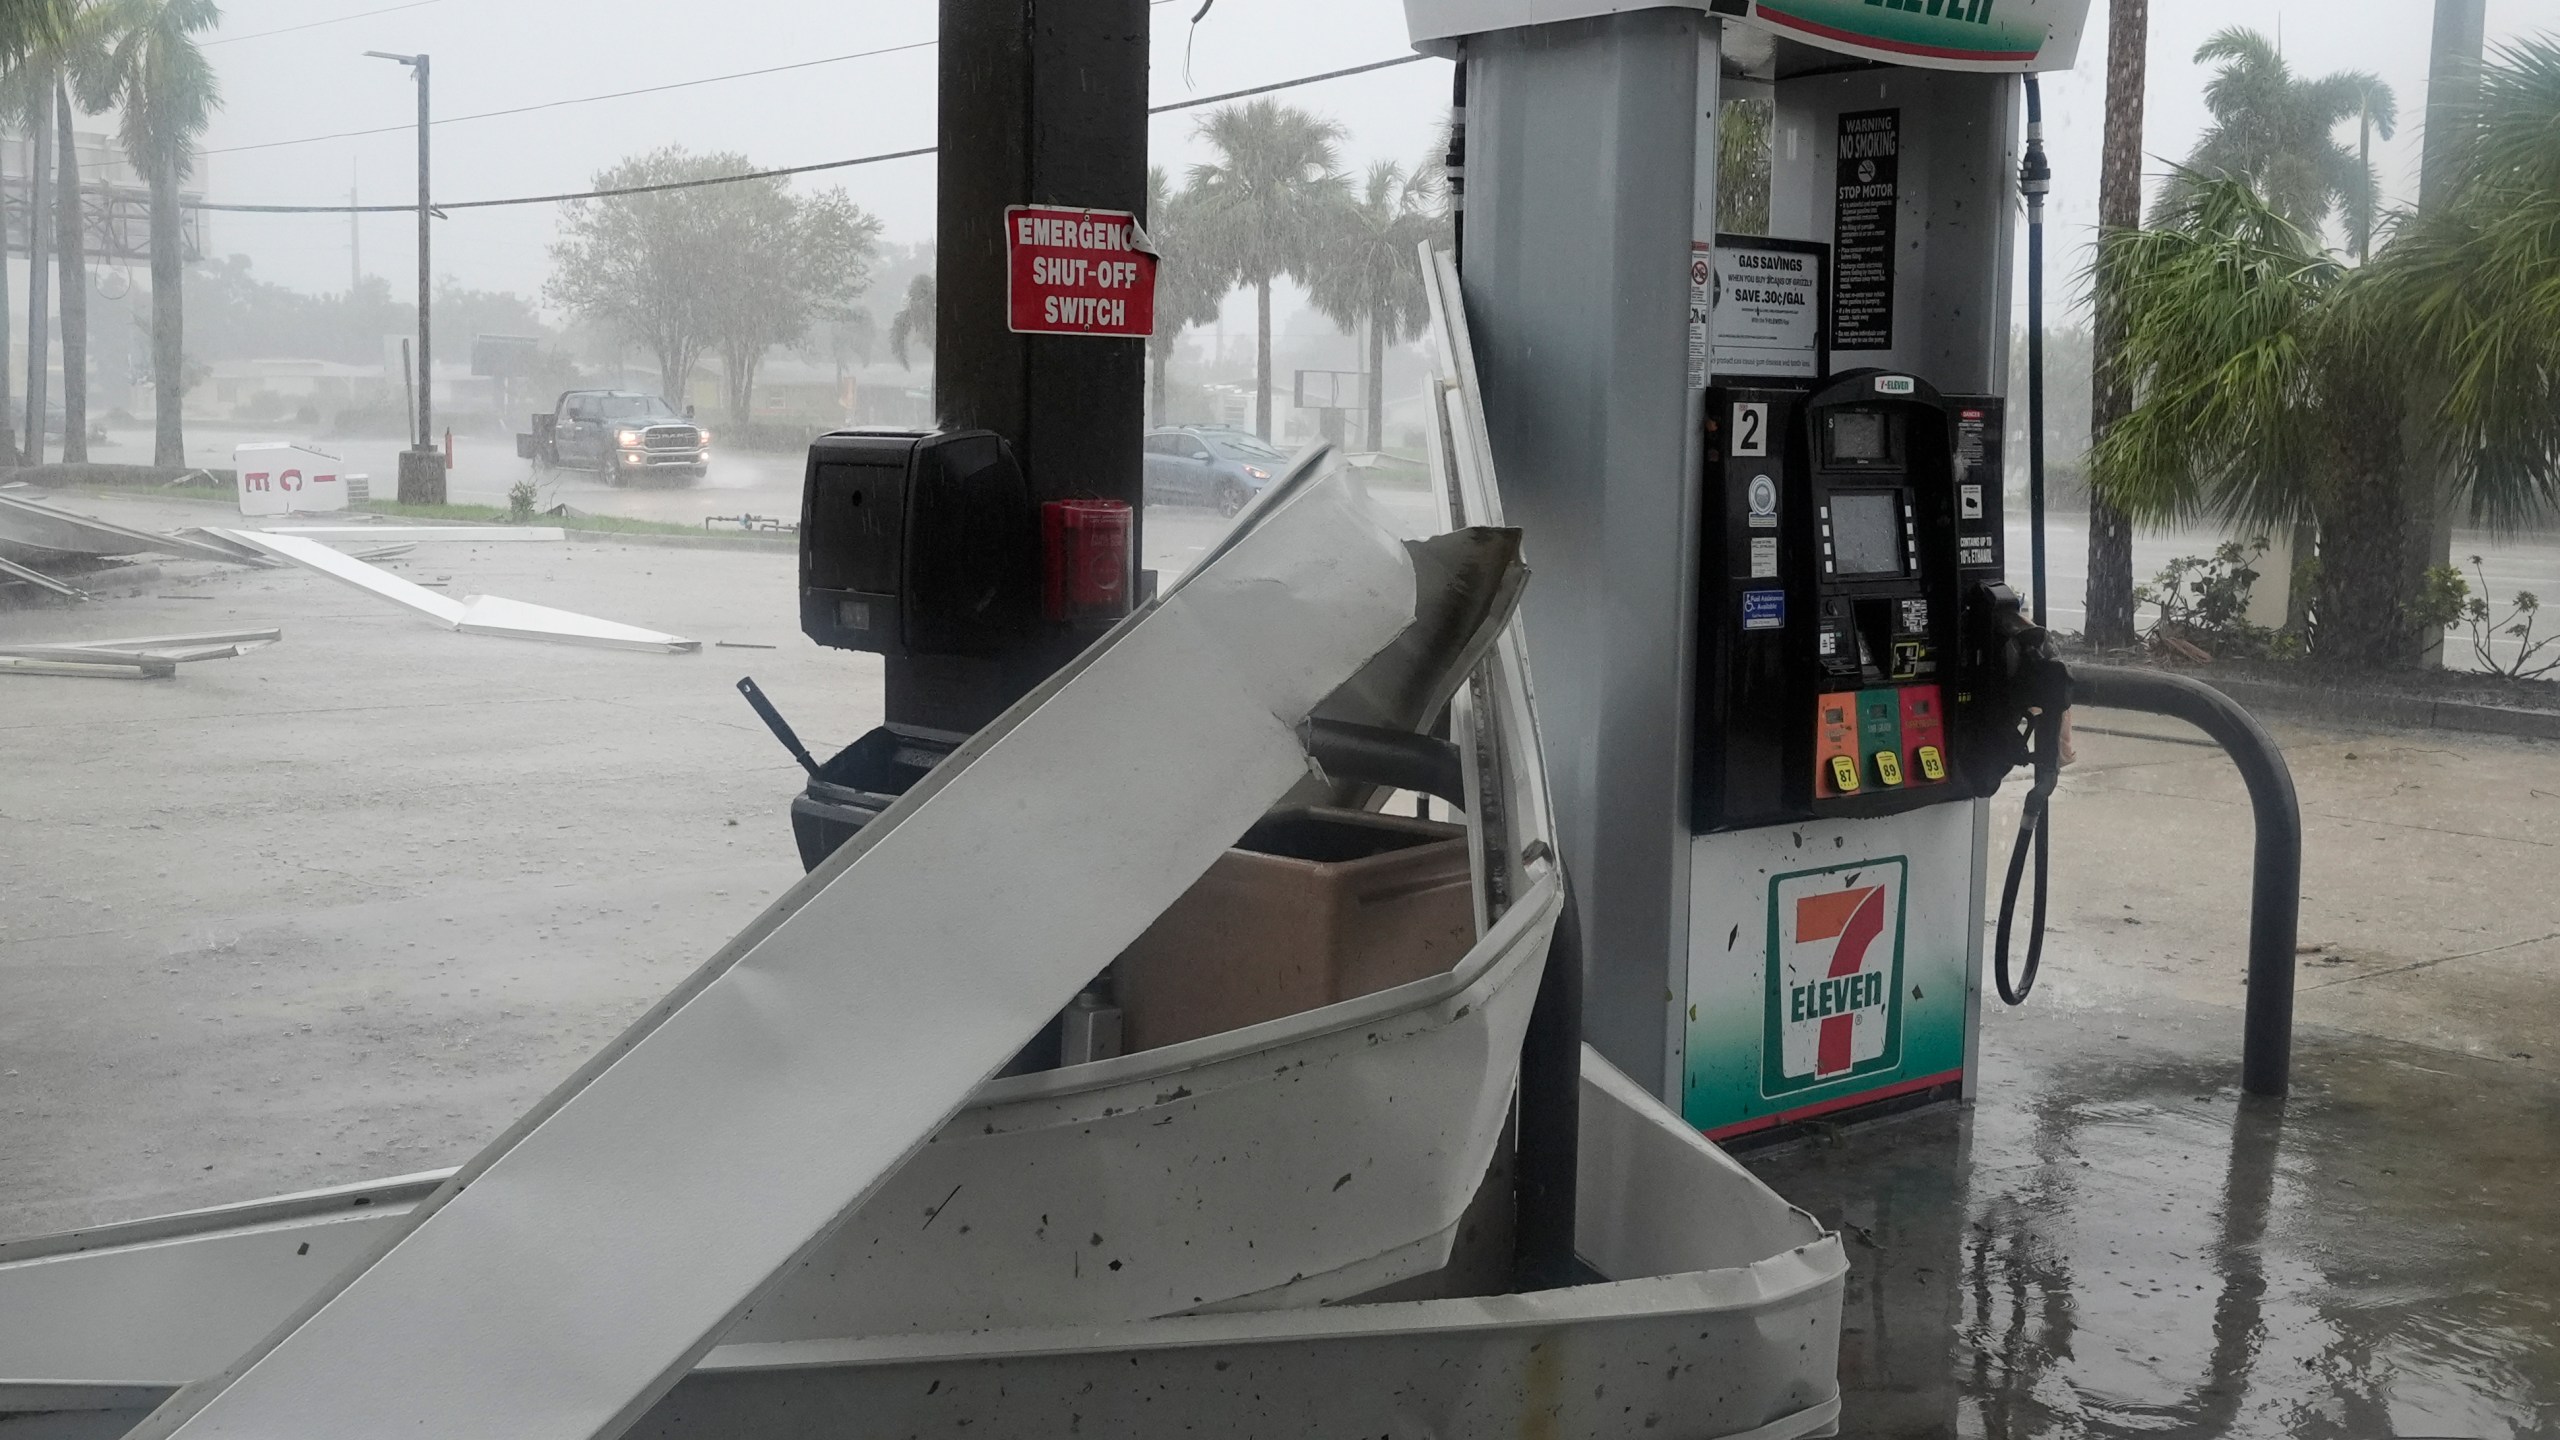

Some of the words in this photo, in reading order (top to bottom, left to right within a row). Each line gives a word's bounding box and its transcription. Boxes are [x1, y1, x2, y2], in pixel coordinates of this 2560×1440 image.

[1846, 117, 1892, 133] WARNING
[1840, 135, 1853, 159] NO
[1855, 131, 1896, 158] SMOKING
[1839, 186, 1860, 199] STOP
[1862, 184, 1892, 197] MOTOR
[1018, 217, 1134, 252] EMERGENC
[1739, 255, 1759, 269] GAS
[1760, 256, 1802, 272] SAVINGS
[1033, 256, 1136, 288] SHUT-OFF
[1728, 274, 1744, 282] WHEN
[1756, 276, 1765, 284] BUY
[1735, 289, 1760, 302] SAVE
[1762, 290, 1806, 306] .30¢/GAL
[1045, 296, 1124, 326] SWITCH
[1740, 410, 1758, 450] 2
[1960, 537, 1980, 547] CONTAINS
[1980, 537, 1985, 546] UP
[1986, 537, 1992, 546] TO
[1960, 550, 1971, 564] 10%
[1971, 549, 1992, 563] ETHANOL
[1884, 764, 1896, 777] 89
[1926, 759, 1938, 772] 93
[1840, 769, 1851, 782] 87
[1796, 883, 1885, 1076] 7
